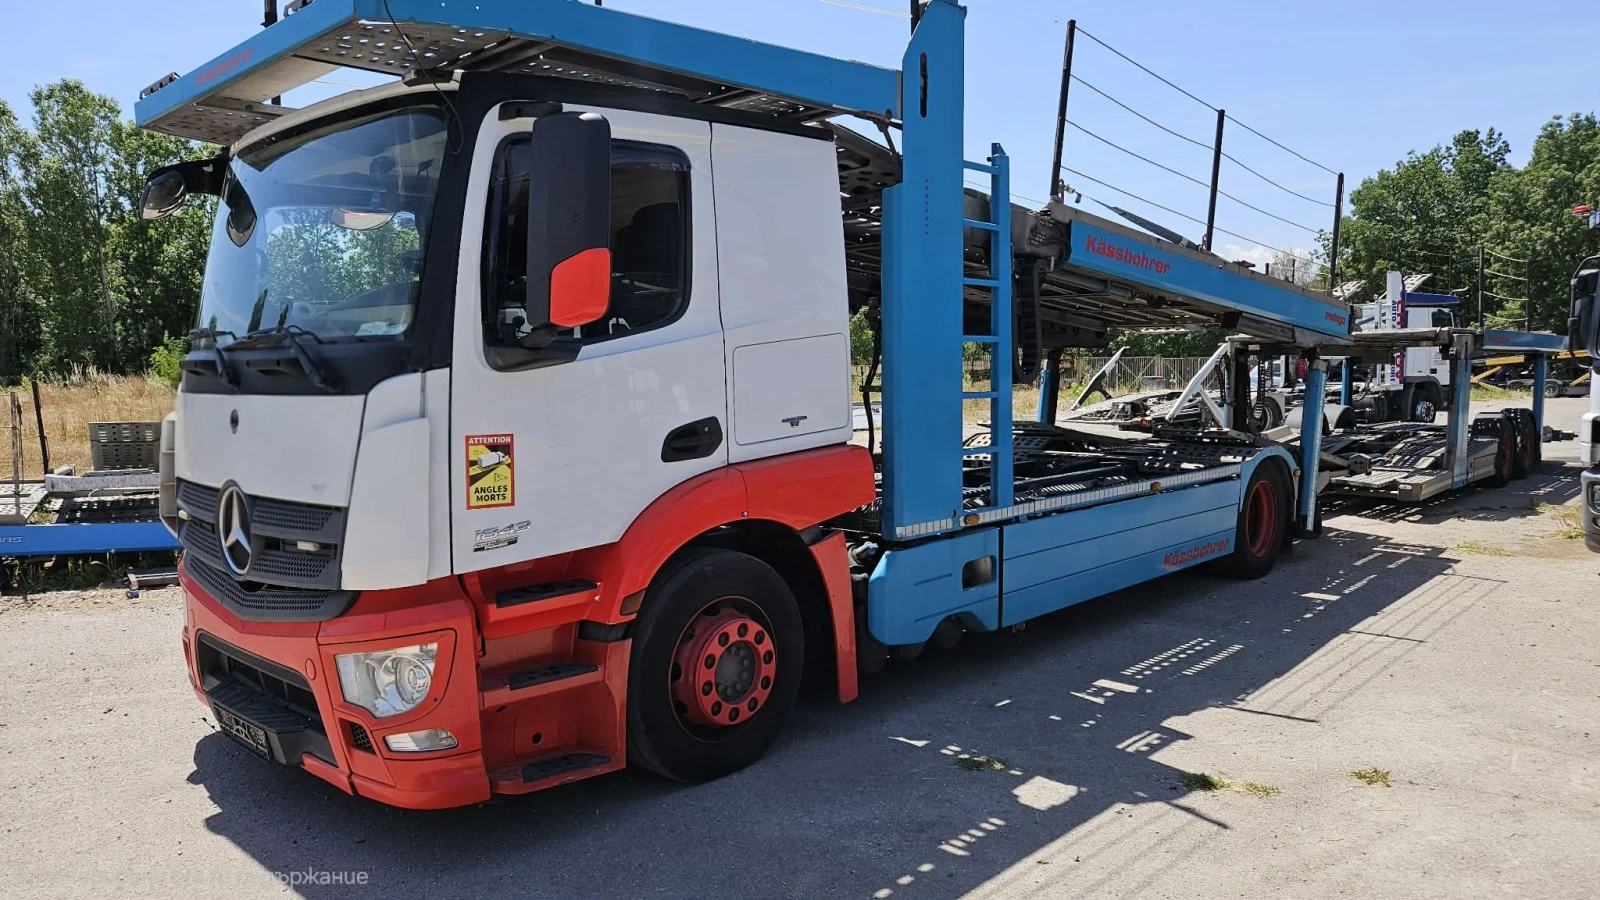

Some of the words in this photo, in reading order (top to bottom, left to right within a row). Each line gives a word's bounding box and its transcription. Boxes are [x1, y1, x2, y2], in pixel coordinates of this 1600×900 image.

[1085, 234, 1171, 274] Kässbohrer
[468, 436, 511, 444] ATTENTION
[474, 484, 508, 495] ANGLES
[476, 493, 507, 502] MORTS
[1163, 539, 1229, 567] Kässbohrer
